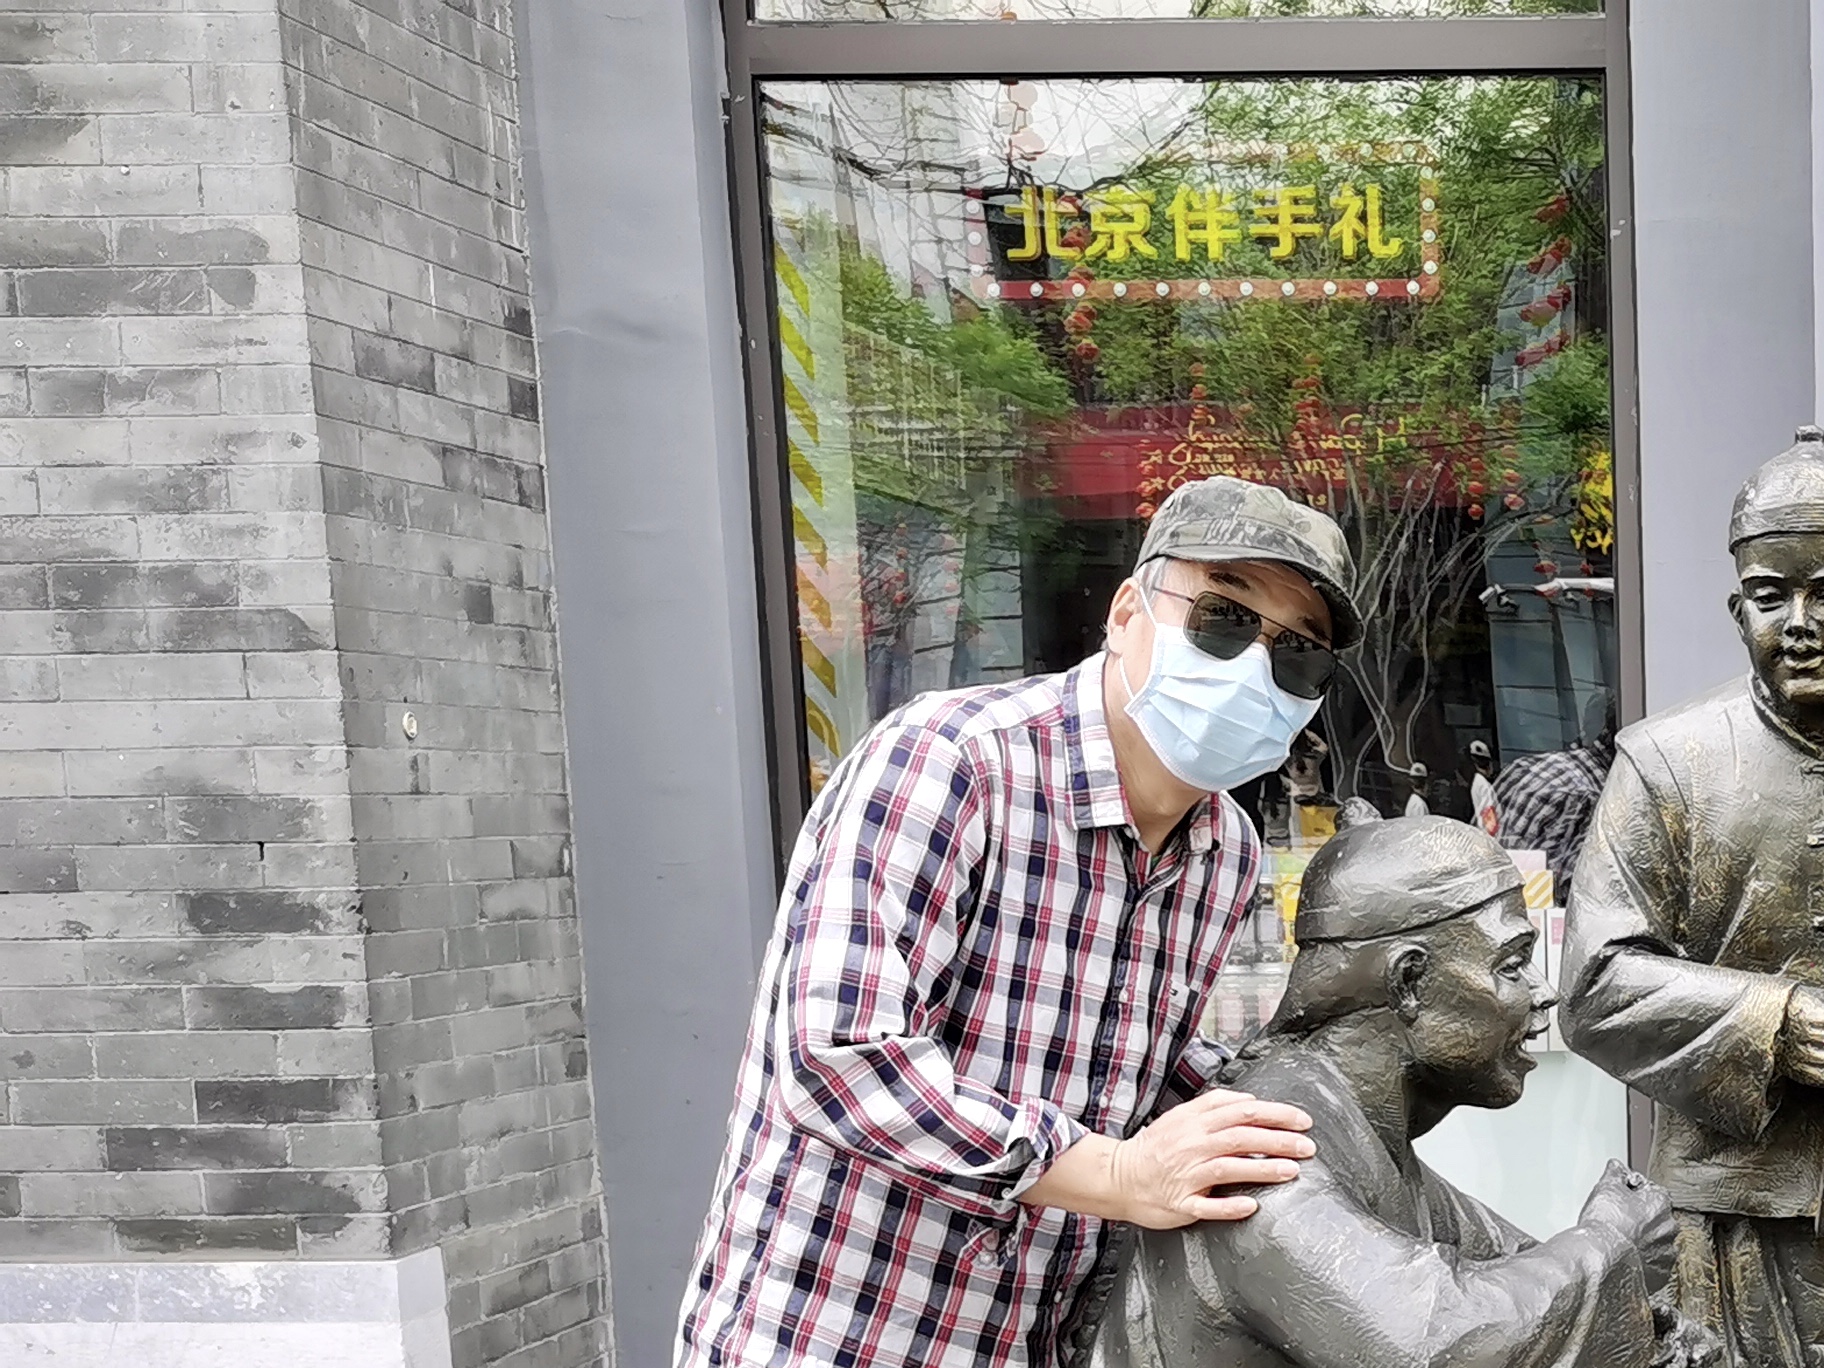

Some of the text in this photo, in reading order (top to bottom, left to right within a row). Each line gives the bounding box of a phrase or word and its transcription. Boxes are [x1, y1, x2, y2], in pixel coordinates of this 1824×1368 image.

[1004, 183, 1402, 263] 北京伴手礼
